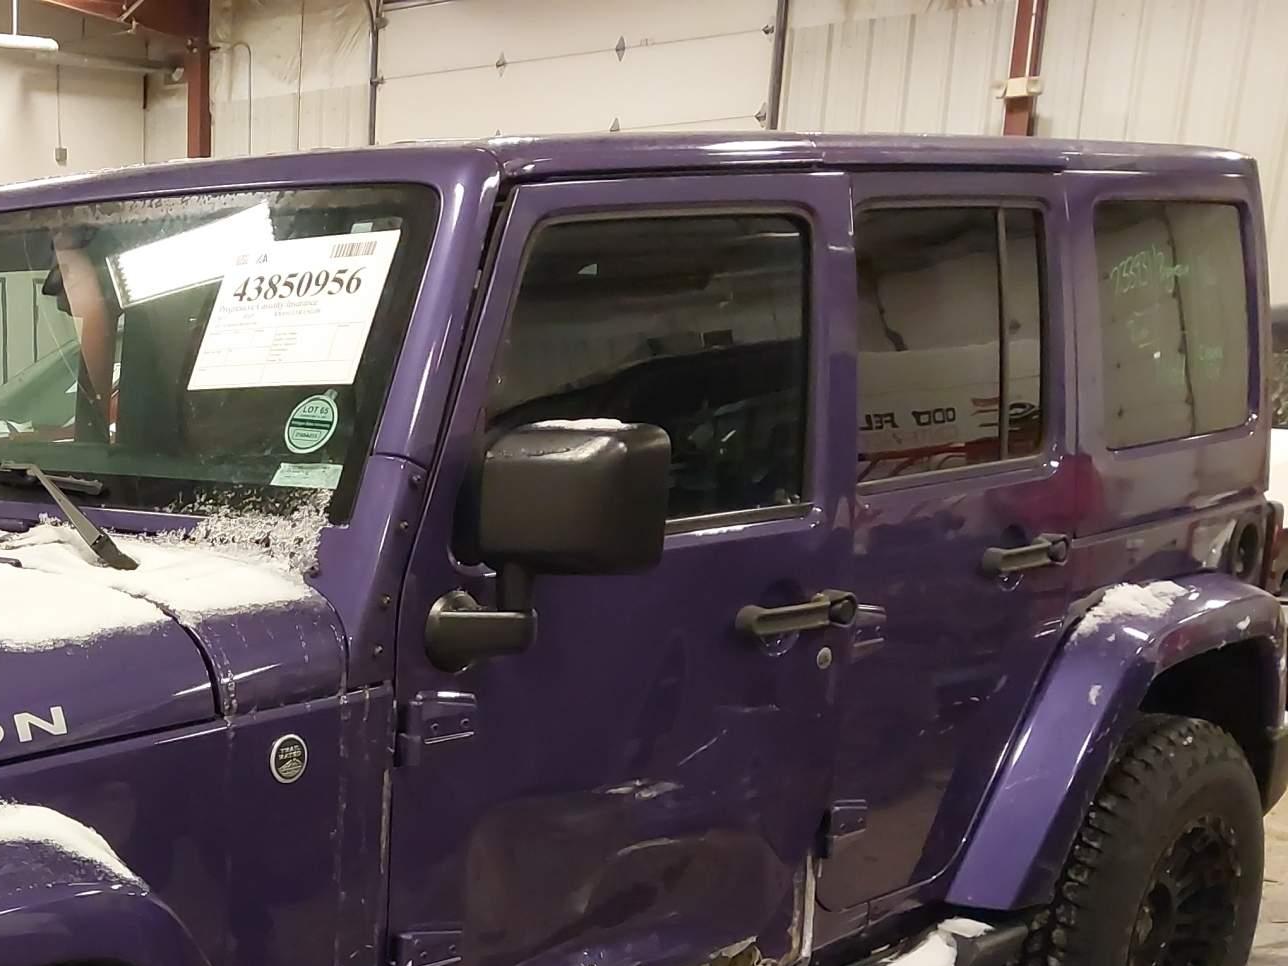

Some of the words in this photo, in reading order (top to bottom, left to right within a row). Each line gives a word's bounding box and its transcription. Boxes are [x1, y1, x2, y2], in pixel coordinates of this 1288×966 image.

[233, 266, 367, 302] 43850956
[303, 405, 318, 414] LOT
[320, 406, 330, 415] 65
